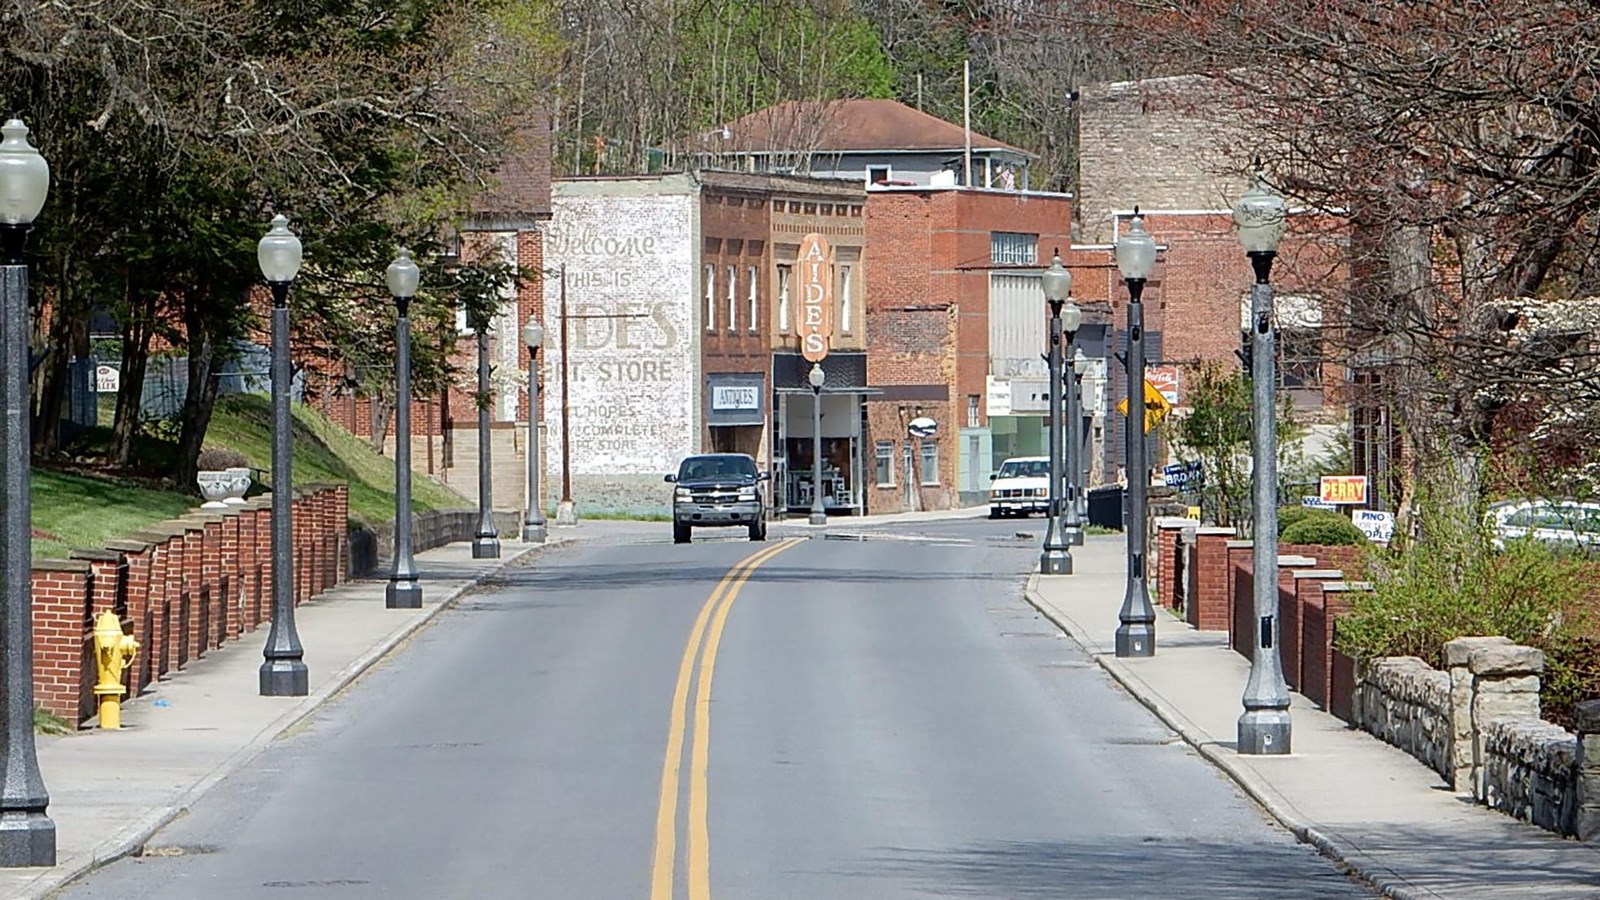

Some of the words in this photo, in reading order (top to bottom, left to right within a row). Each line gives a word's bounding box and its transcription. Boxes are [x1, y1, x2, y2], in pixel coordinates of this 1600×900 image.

[546, 226, 655, 256] Welcome
[566, 272, 603, 288] THIS
[614, 271, 632, 288] IS
[597, 359, 672, 382] STORE
[719, 388, 753, 408] ANTIQUES
[596, 439, 638, 451] STORE
[1323, 481, 1364, 498] PERRY
[1361, 512, 1385, 521] PINO
[1364, 530, 1392, 540] OPLE
